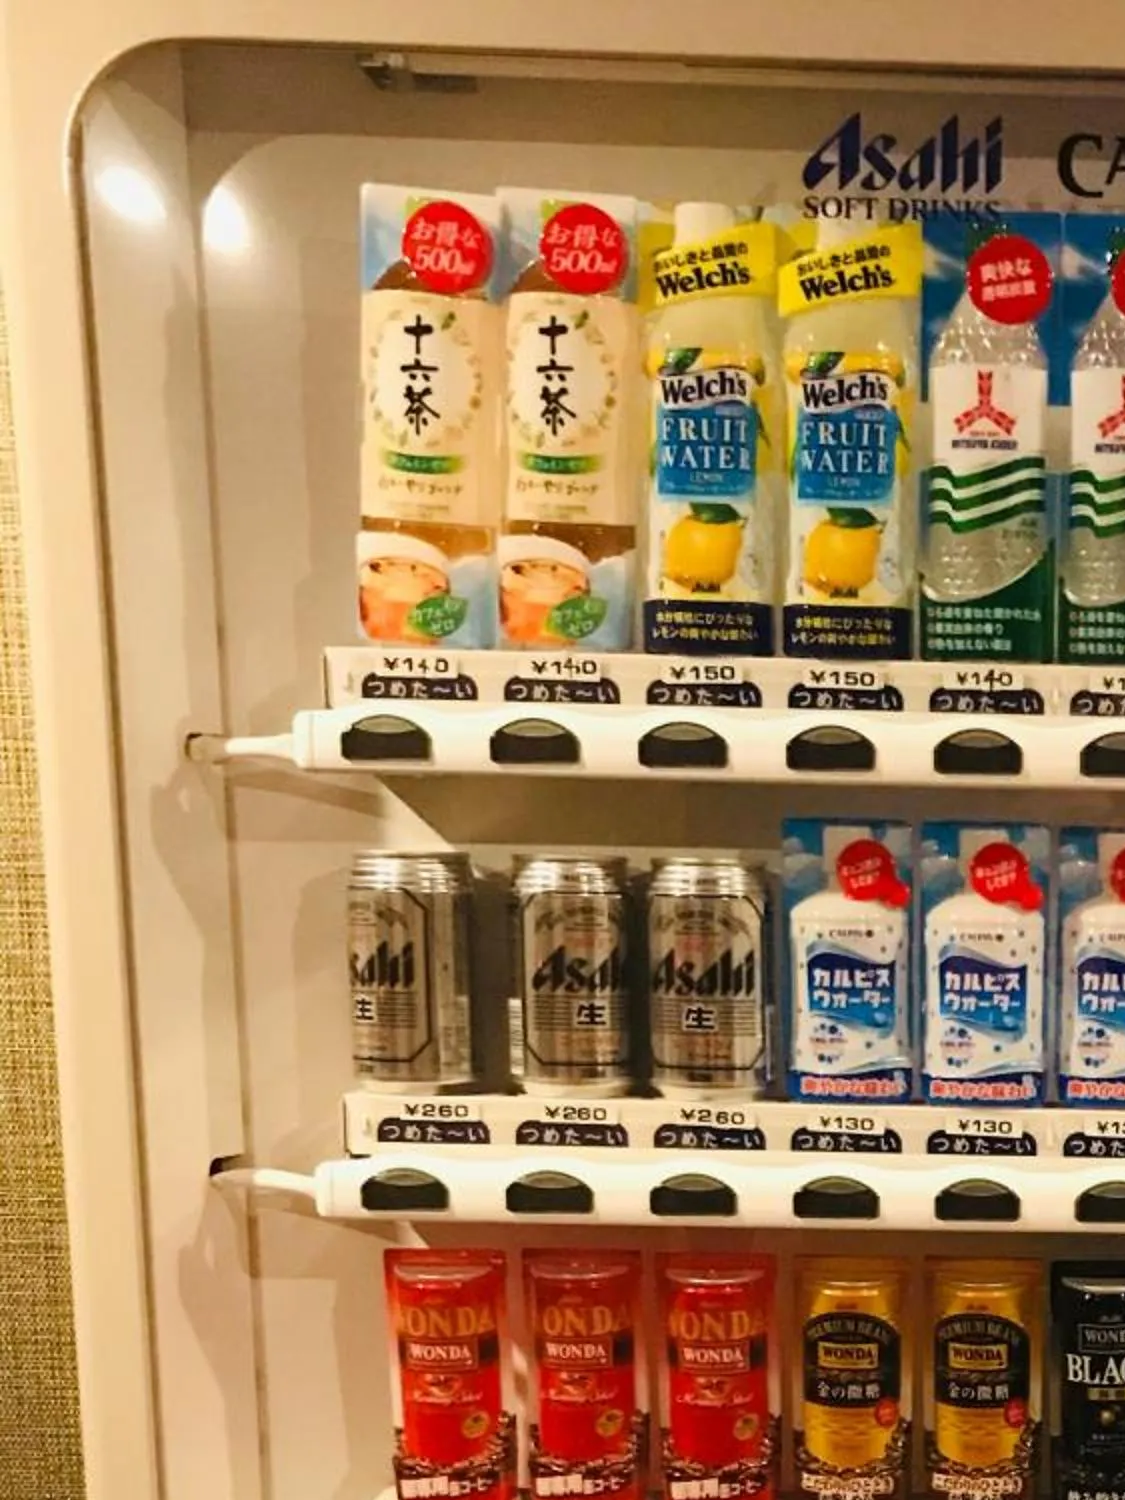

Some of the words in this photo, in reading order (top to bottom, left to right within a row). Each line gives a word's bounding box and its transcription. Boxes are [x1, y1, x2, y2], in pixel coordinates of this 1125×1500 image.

[802, 112, 1004, 194] Asahi
[803, 197, 880, 220] SOFT
[889, 198, 1001, 222] DRINKS
[410, 218, 481, 248] お得な
[546, 222, 618, 249] お得な
[656, 262, 750, 298] Welch's
[799, 264, 893, 301] Welch's
[400, 315, 440, 436] 十六茶
[537, 315, 577, 436] 十六茶
[661, 372, 748, 404] Welch's
[803, 372, 888, 409] Welch's
[662, 418, 748, 442] FRUIT
[801, 421, 888, 446] FRUIT
[384, 658, 449, 674] ¥140
[532, 659, 596, 676] ¥140
[671, 667, 734, 681] ¥150
[810, 672, 874, 686] ¥150
[957, 670, 1013, 688] ¥140
[654, 949, 754, 996] Asahi
[813, 968, 891, 988] カルピス
[944, 971, 1021, 991] カルピス
[577, 1003, 606, 1025] 生
[685, 1008, 715, 1030] 生
[405, 1104, 468, 1118] ¥260
[545, 1106, 607, 1121] ¥260
[680, 1109, 744, 1124] ¥260
[820, 1116, 874, 1130] ¥130
[957, 1120, 1012, 1134] ¥130
[410, 1344, 471, 1360] WONDA
[546, 1342, 606, 1358] WONDA
[683, 1348, 743, 1363] WONDA
[823, 1349, 874, 1361] WONDA
[953, 1349, 1003, 1361] WONDA
